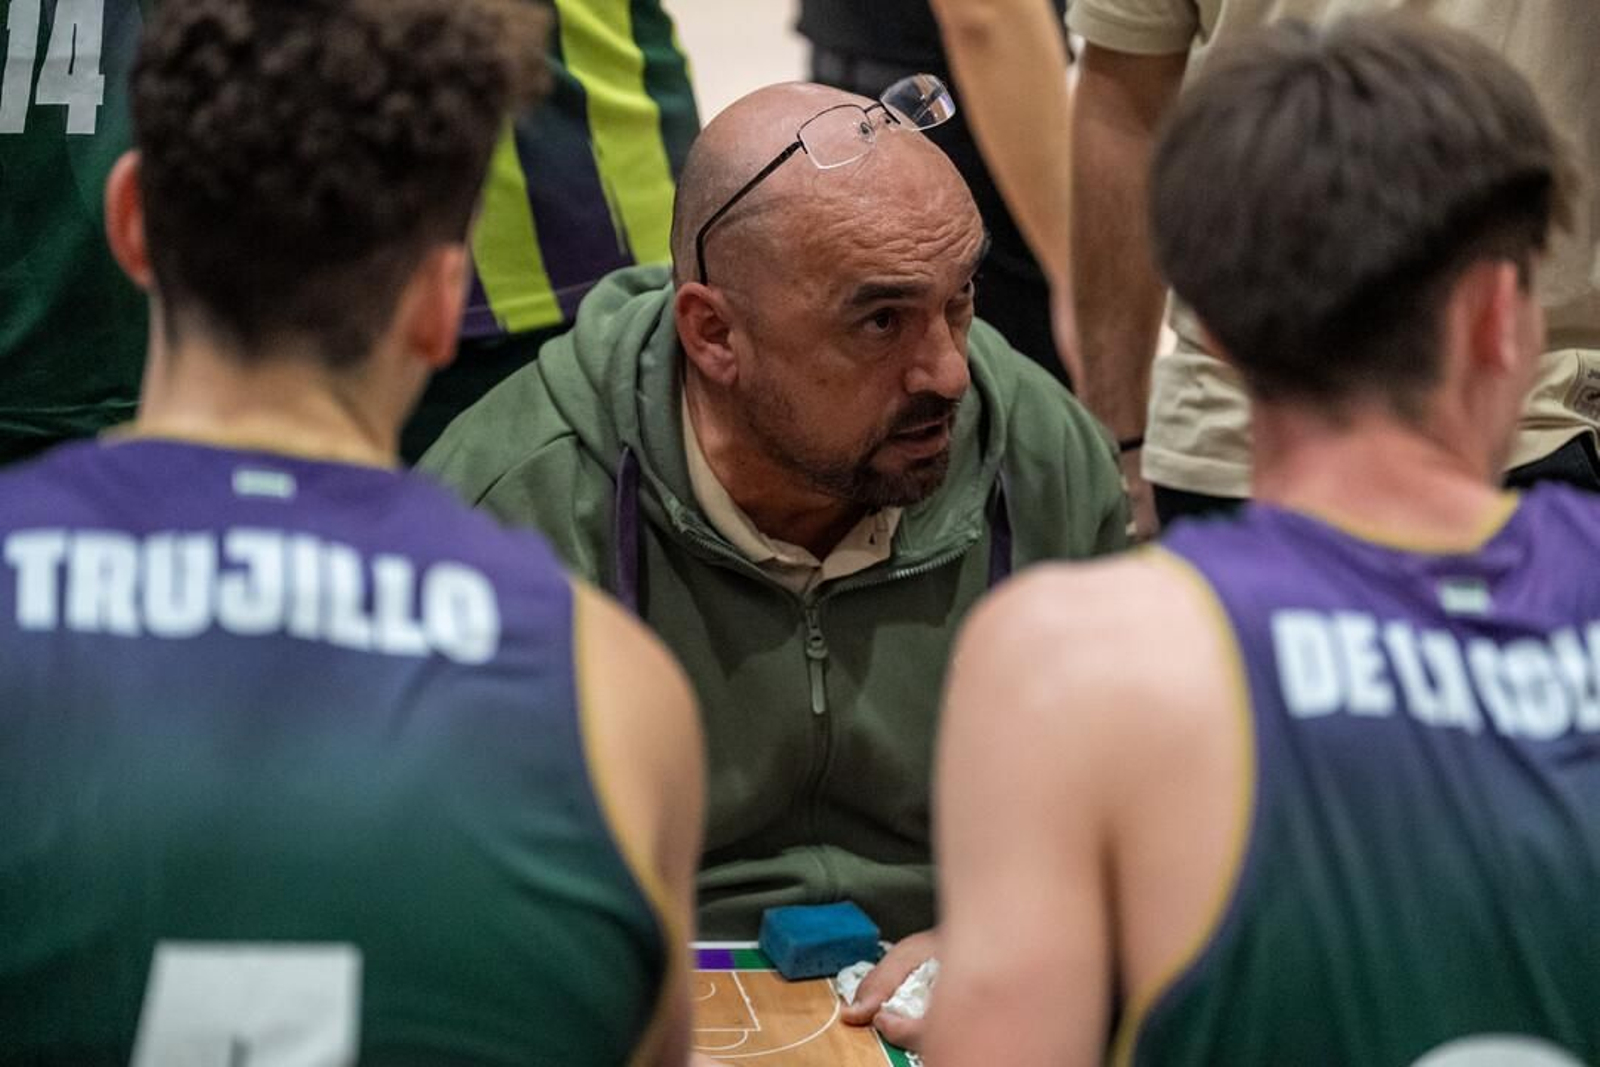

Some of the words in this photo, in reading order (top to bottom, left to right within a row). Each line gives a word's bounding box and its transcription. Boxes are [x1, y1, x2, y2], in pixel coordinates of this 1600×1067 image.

[0, 0, 105, 134] 14
[3, 526, 500, 666] TRUJILLO
[1271, 608, 1397, 720] DE
